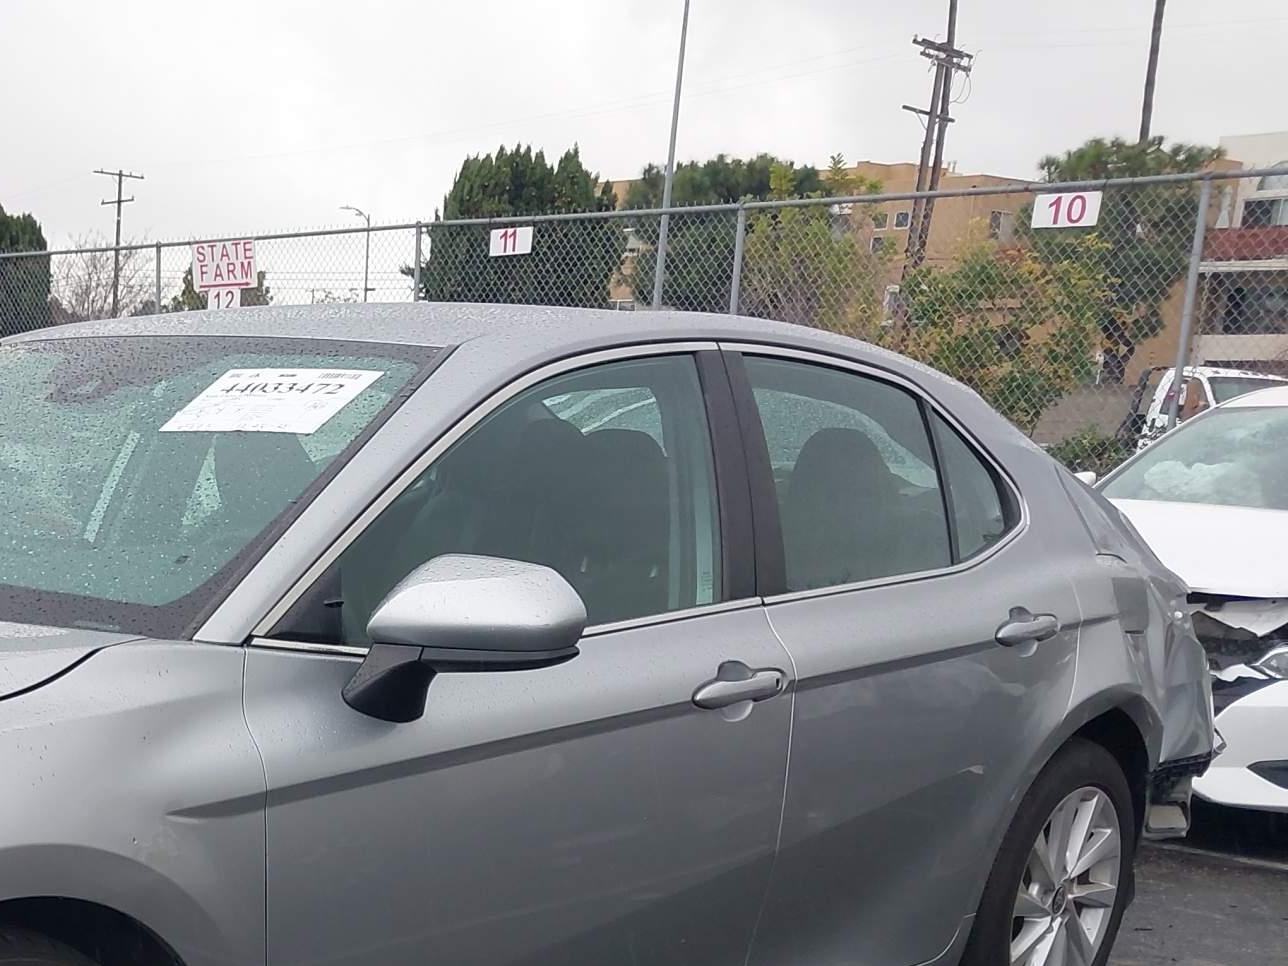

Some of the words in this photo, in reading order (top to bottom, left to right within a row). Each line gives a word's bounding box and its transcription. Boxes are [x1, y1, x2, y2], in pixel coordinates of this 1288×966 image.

[1048, 194, 1087, 225] 10
[196, 241, 254, 263] STATE
[499, 229, 517, 254] 11
[199, 260, 253, 282] FARM
[214, 290, 235, 310] 12
[220, 382, 345, 395] 44033472
